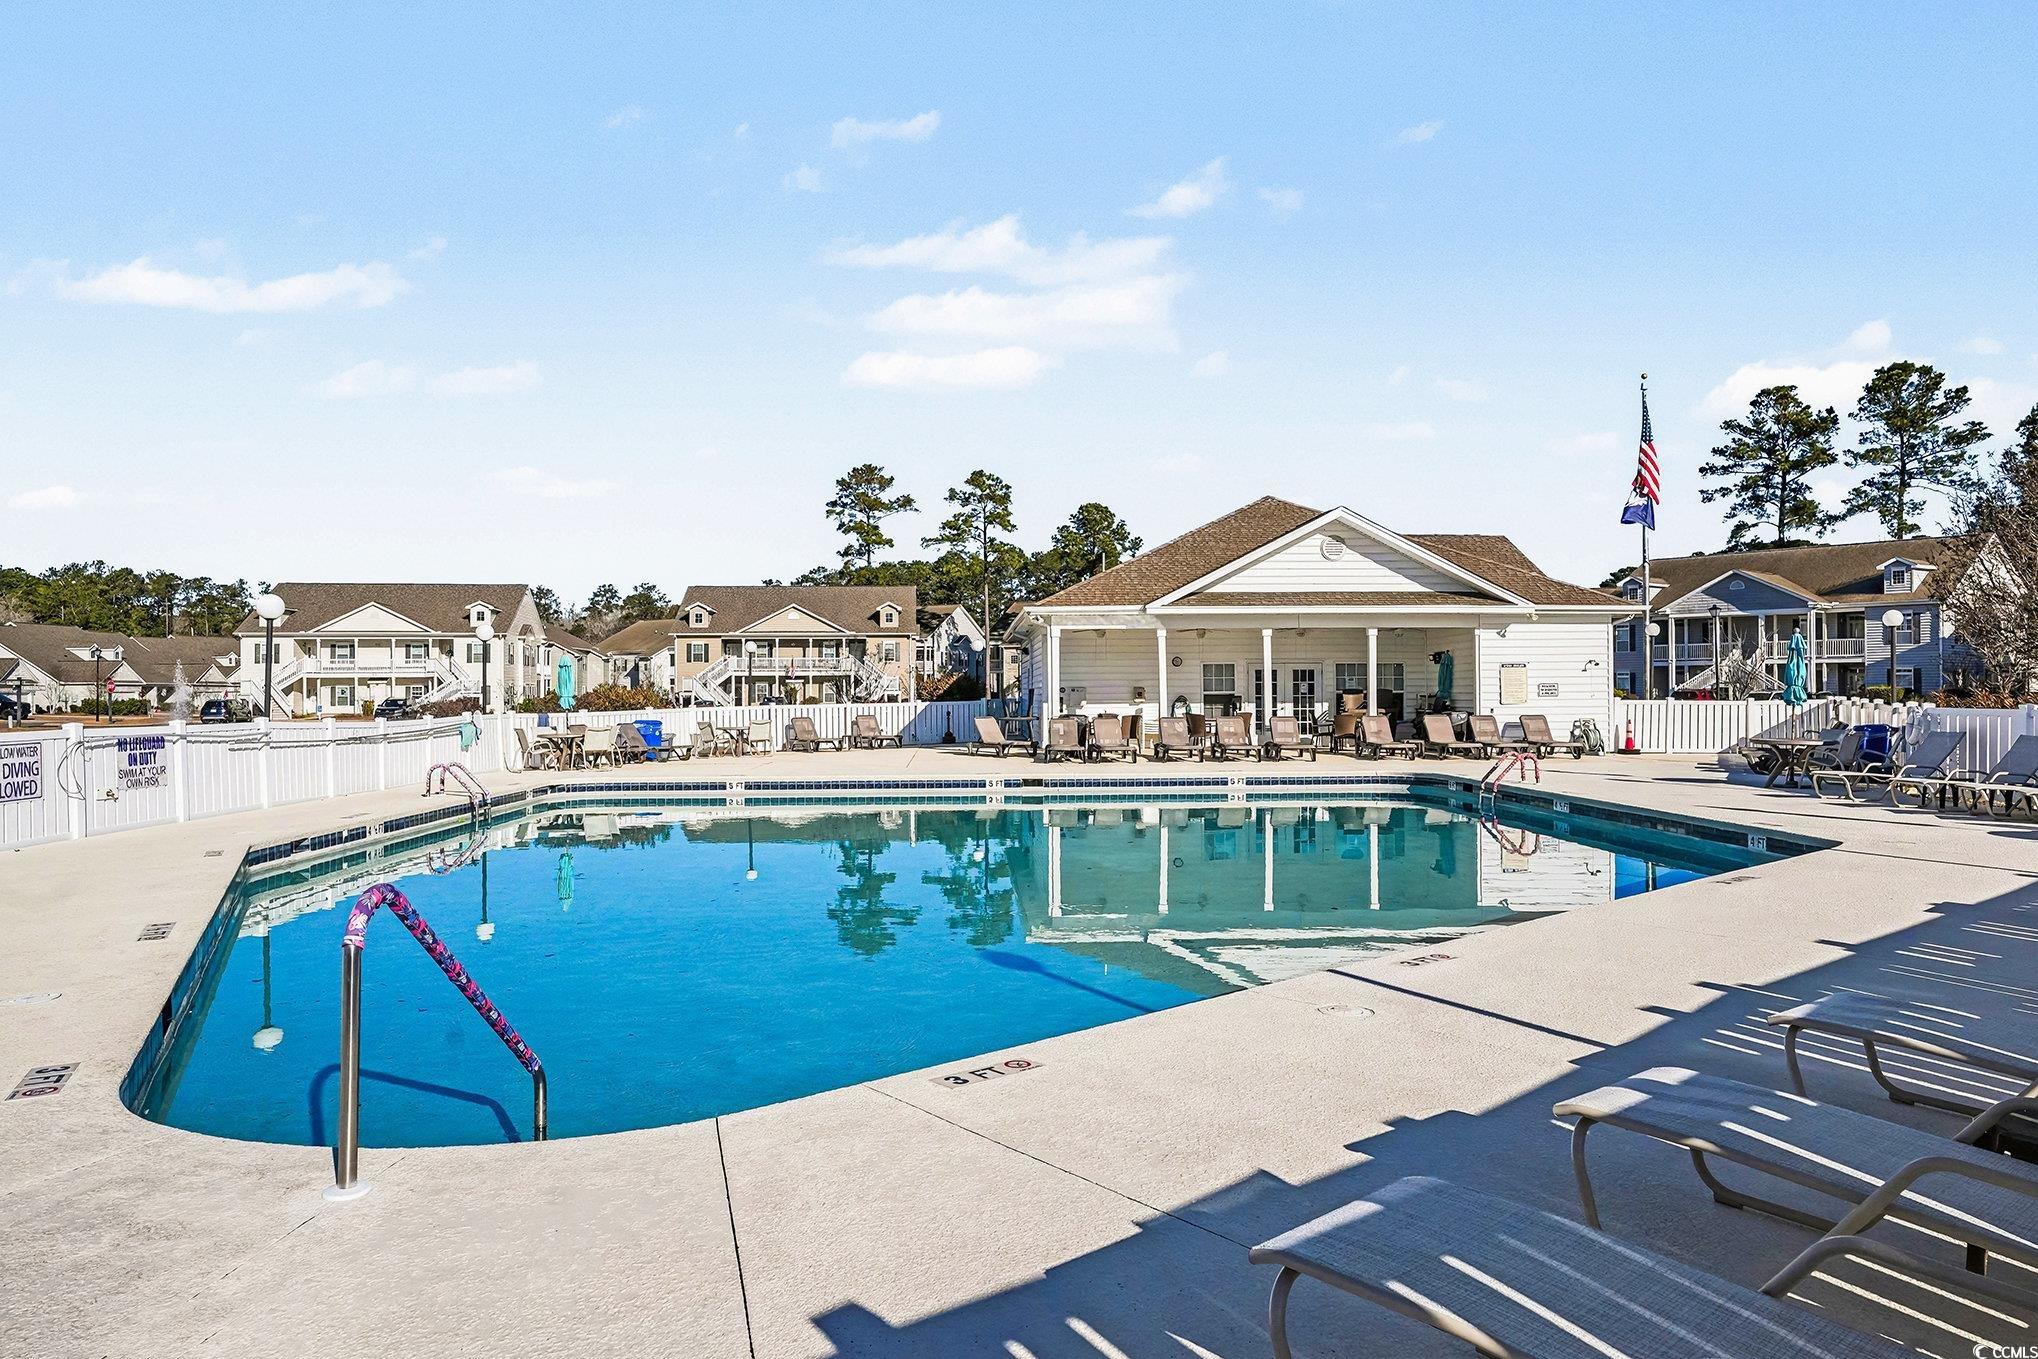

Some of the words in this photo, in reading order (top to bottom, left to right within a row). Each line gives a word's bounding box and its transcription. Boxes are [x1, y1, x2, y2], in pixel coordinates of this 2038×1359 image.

[129, 736, 166, 751] LIFEGUARD
[16, 746, 38, 758] WATER
[128, 752, 138, 766] ON
[139, 751, 157, 765] DUTY
[3, 761, 39, 779] DIVING
[118, 769, 138, 779] SWIM
[138, 767, 147, 777] AT
[147, 765, 166, 776] YOUR
[35, 1066, 71, 1074] 3
[944, 1076, 969, 1085] 3
[968, 1066, 1005, 1079] FT
[24, 1074, 66, 1087] FT
